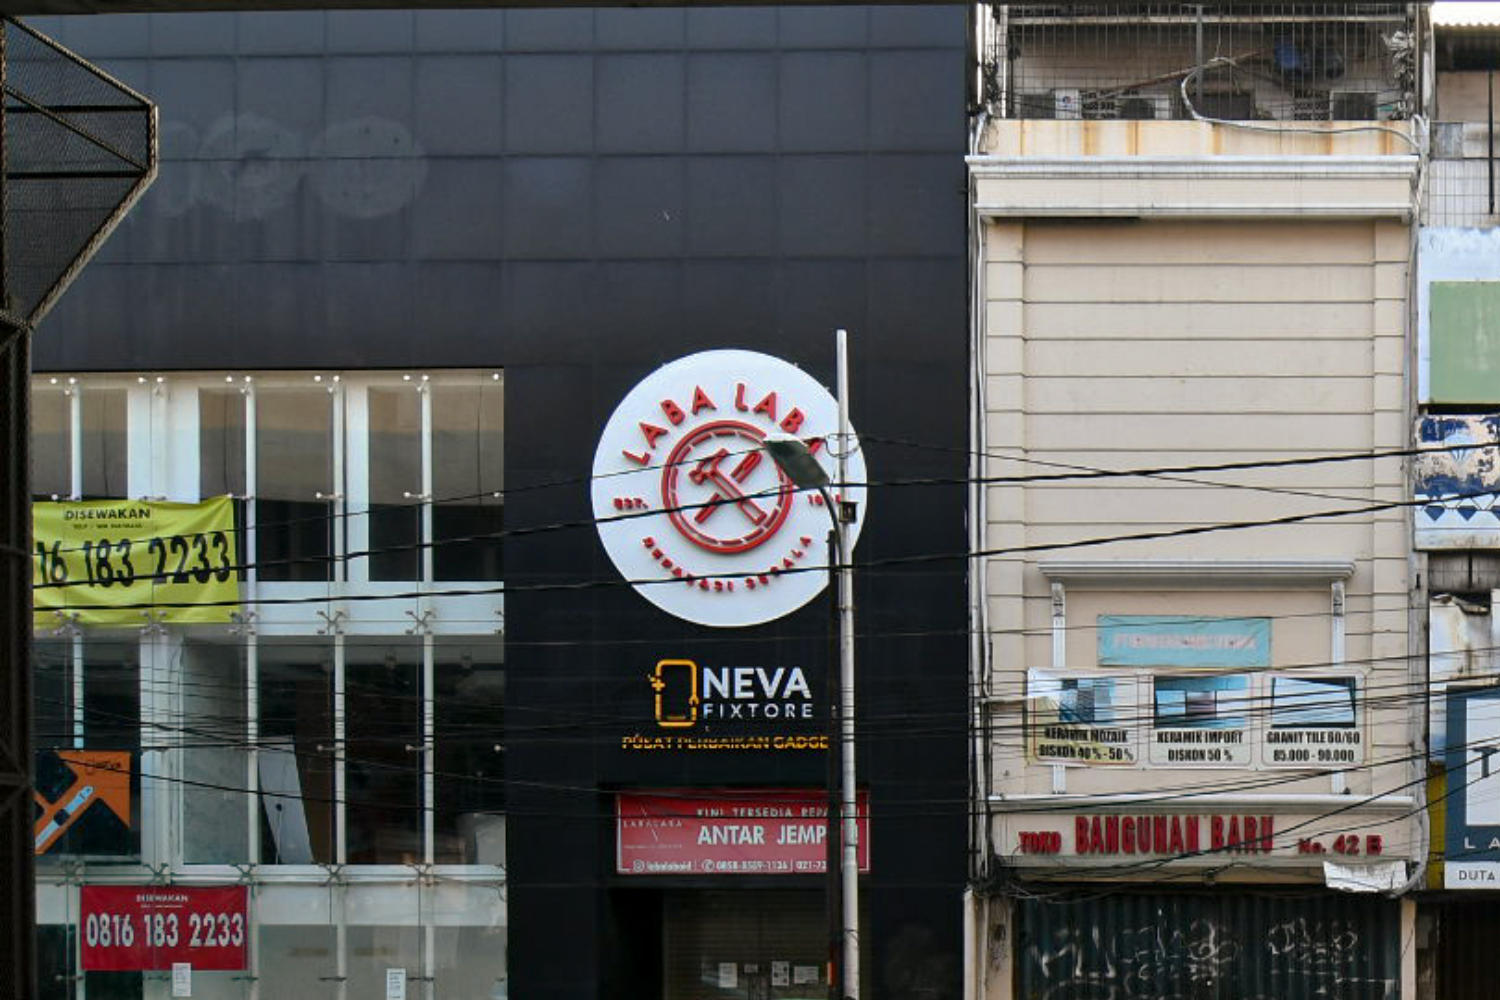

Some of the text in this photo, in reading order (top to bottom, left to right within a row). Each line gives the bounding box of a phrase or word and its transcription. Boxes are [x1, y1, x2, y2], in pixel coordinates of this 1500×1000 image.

[622, 384, 717, 466] LABA
[64, 508, 151, 521] DISEWAKAN
[83, 538, 135, 588] 183
[149, 530, 230, 584] 2233
[702, 667, 812, 699] NEVA
[702, 703, 814, 719] FIXTORE
[1157, 731, 1244, 744] KERAMIK IMPORT
[1266, 731, 1304, 744] GRANIT
[1306, 731, 1326, 744] TILE
[1168, 748, 1206, 762] DISKON
[697, 825, 766, 846] ANTAR
[1074, 815, 1200, 855] BANGUNAN
[1458, 869, 1496, 882] DUTA
[86, 911, 244, 949] 0816 183 2233
